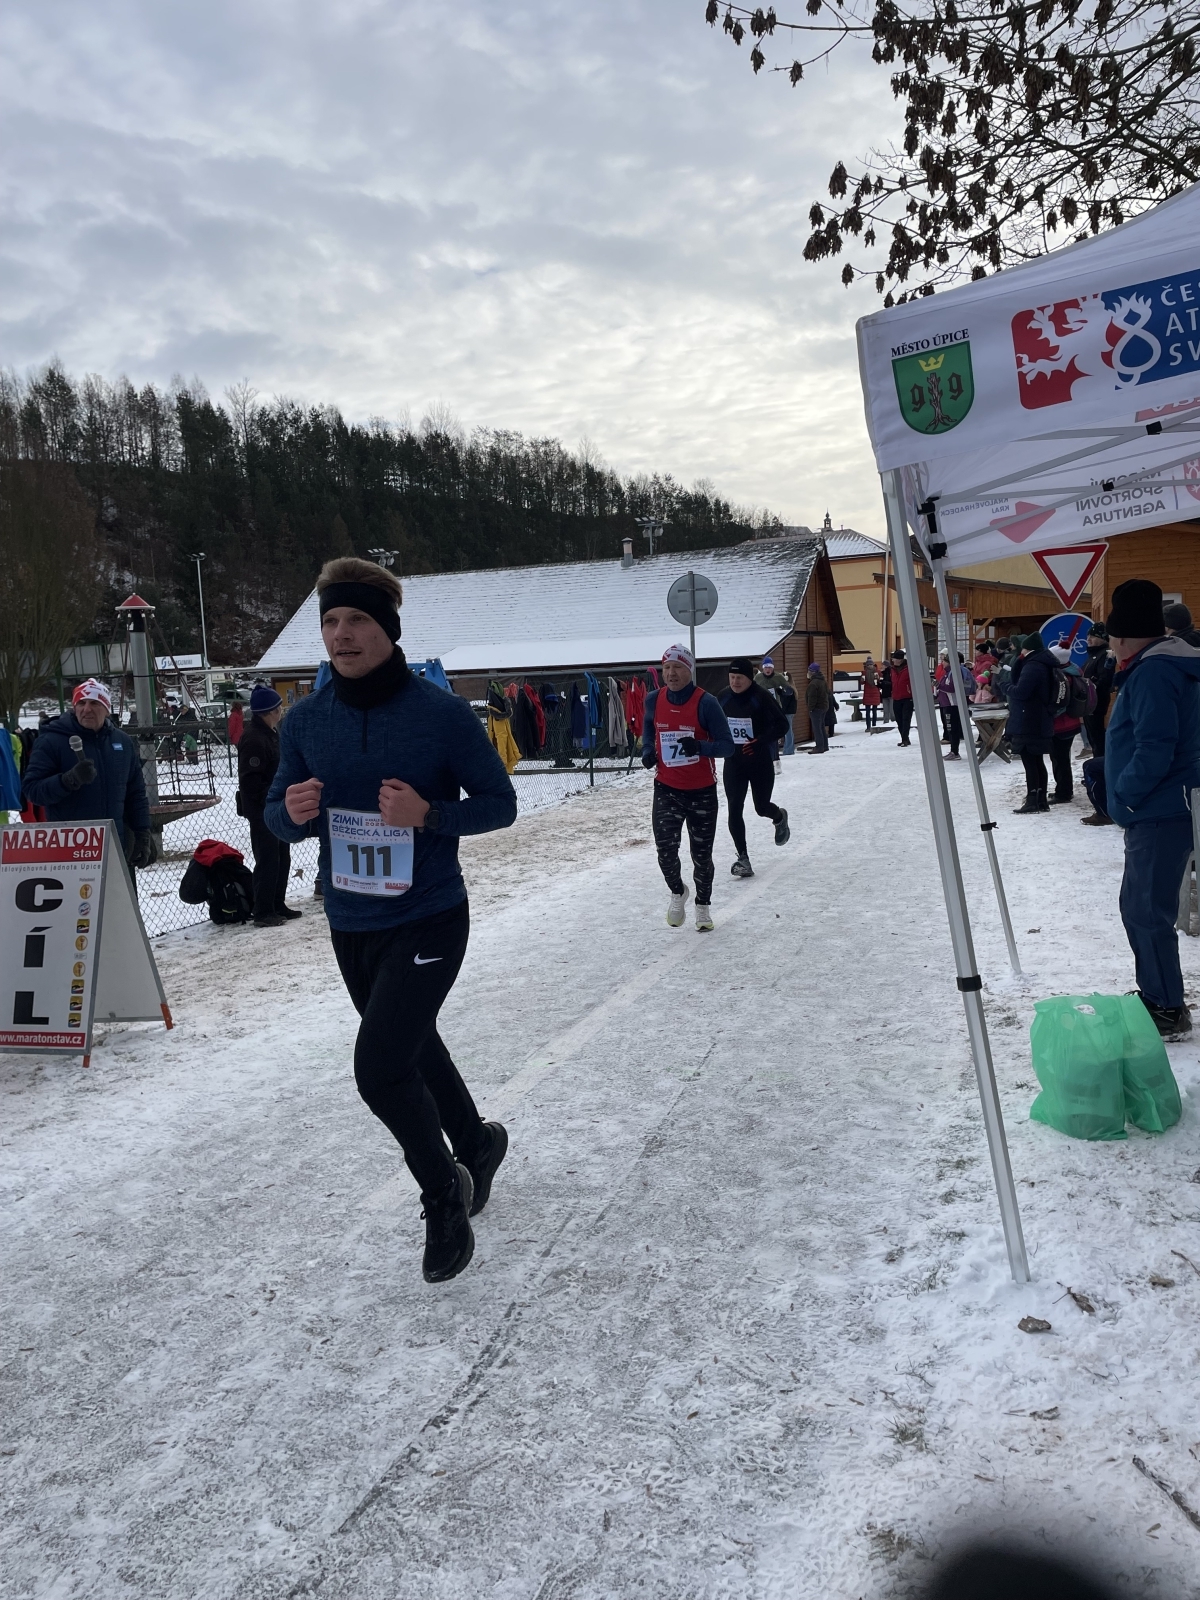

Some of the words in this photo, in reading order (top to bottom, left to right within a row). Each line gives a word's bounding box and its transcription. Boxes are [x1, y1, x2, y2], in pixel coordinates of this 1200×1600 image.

[1160, 282, 1200, 306] ČE
[891, 339, 930, 357] MĚSTO
[932, 328, 970, 347] ÚPICE
[733, 727, 747, 738] 98
[332, 813, 363, 827] ZIMNÍ
[332, 824, 381, 837] BĚŽECKÁ
[384, 829, 410, 837] LIGA
[3, 827, 104, 850] MARATON
[72, 849, 99, 858] stav
[347, 844, 392, 877] 111
[1, 864, 47, 873] tělovýchovná
[50, 864, 77, 872] jednota
[81, 863, 101, 871] Úpice
